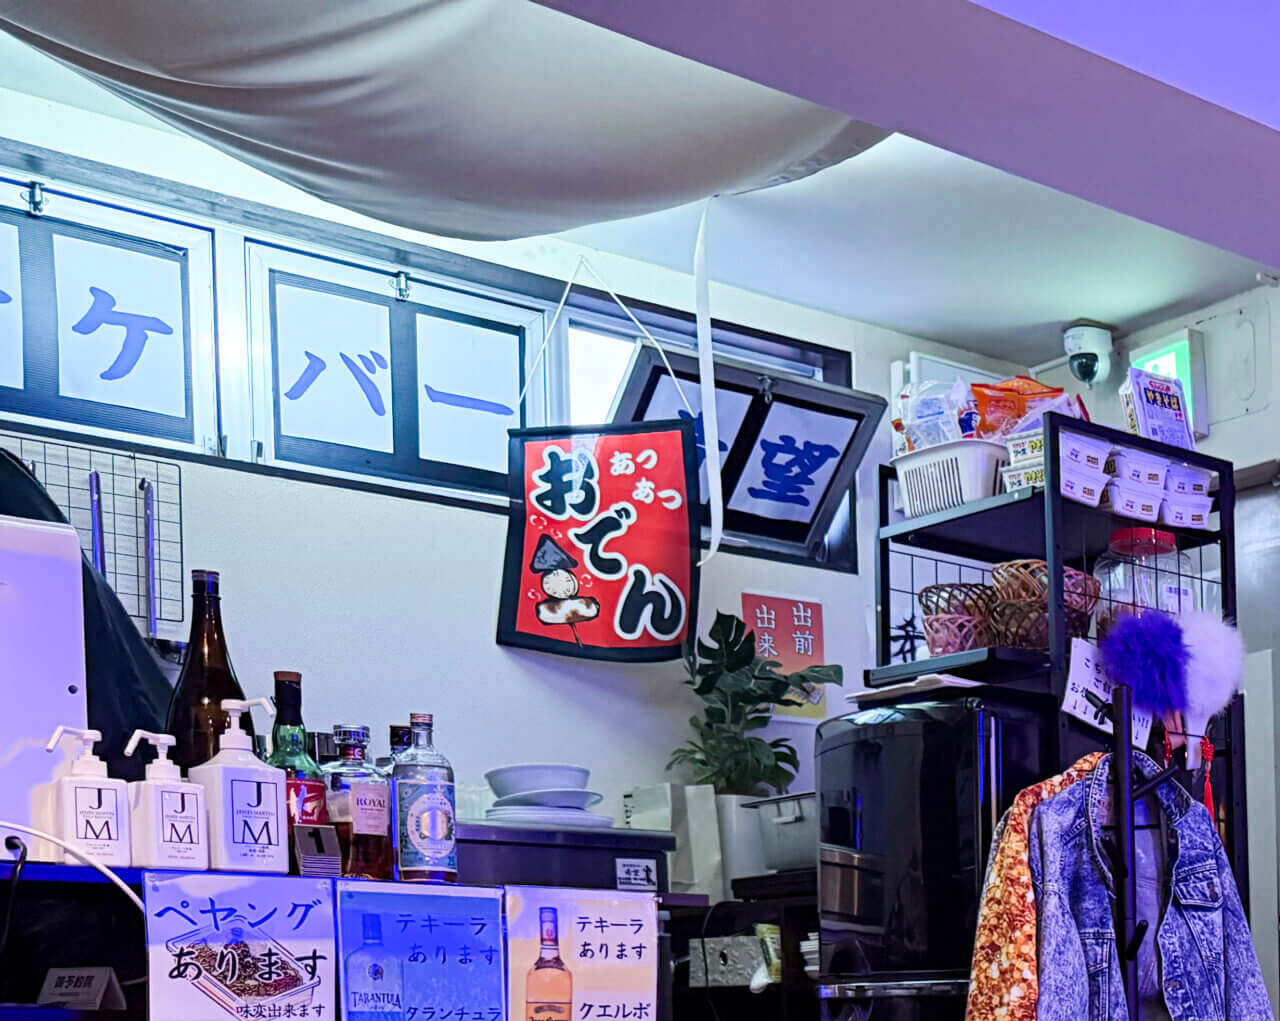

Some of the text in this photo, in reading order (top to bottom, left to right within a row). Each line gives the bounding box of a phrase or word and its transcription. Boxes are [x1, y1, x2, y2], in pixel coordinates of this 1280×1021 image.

[0, 286, 515, 417] ケバー
[532, 446, 686, 641] おでん
[755, 604, 778, 658] 出来
[791, 602, 814, 657] 出前
[89, 788, 102, 810] J
[173, 793, 186, 814] J
[247, 782, 262, 808] J
[85, 819, 112, 841] M
[170, 823, 194, 844] M
[242, 819, 273, 846] M
[308, 828, 325, 854] 1
[154, 897, 323, 931] ペヤング
[396, 913, 489, 936] テキーラ
[576, 915, 645, 936] テキーラ
[407, 945, 499, 966] あります
[579, 942, 648, 960] あります
[168, 947, 328, 982] あります
[236, 1003, 326, 1020] 味変出来ます
[580, 1002, 651, 1020] クエルボ
